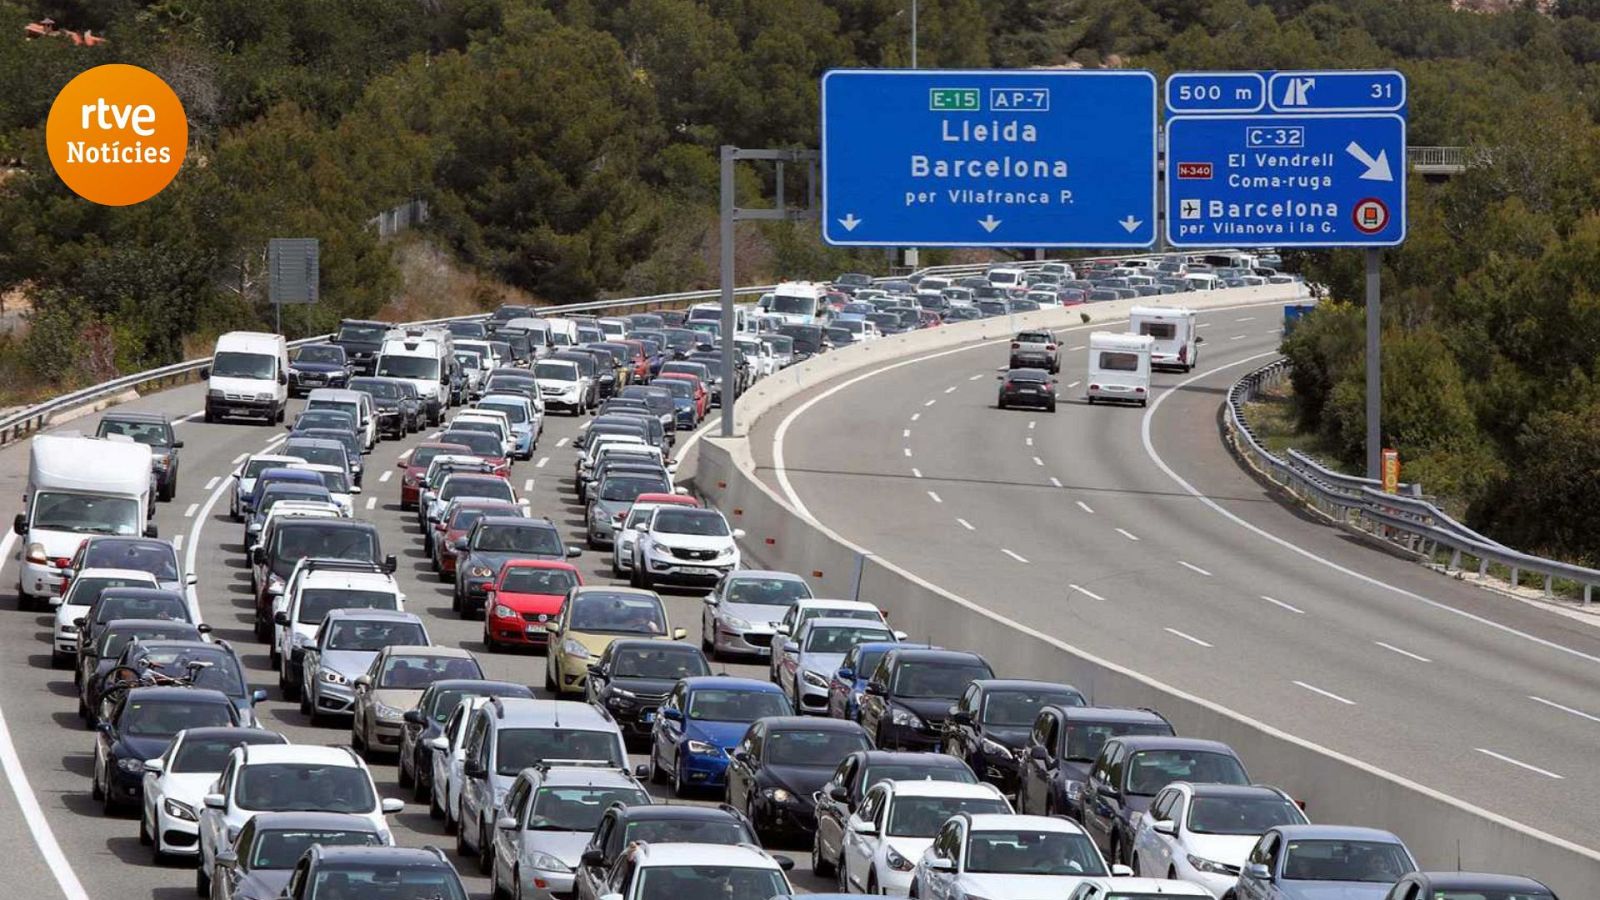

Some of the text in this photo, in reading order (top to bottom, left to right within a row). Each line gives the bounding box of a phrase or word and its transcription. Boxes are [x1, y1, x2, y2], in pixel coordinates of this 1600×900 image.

[1179, 85, 1252, 101] 500 m
[1371, 83, 1391, 98] 31
[934, 92, 975, 107] E-15
[995, 92, 1045, 107] AP-7
[942, 119, 1037, 142] Lleida
[1250, 130, 1301, 145] C-32
[911, 155, 1068, 178] Barcelona
[1228, 153, 1333, 168] El Vendrell
[1179, 166, 1211, 175] N-340
[1228, 173, 1332, 190] Coma-ruga
[906, 189, 1074, 206] per Vilafranca P.
[1209, 199, 1338, 218] Barcelona
[1179, 224, 1205, 237] per
[1213, 222, 1283, 234] Vilanova
[1300, 222, 1315, 233] la
[1321, 221, 1336, 233] G.
